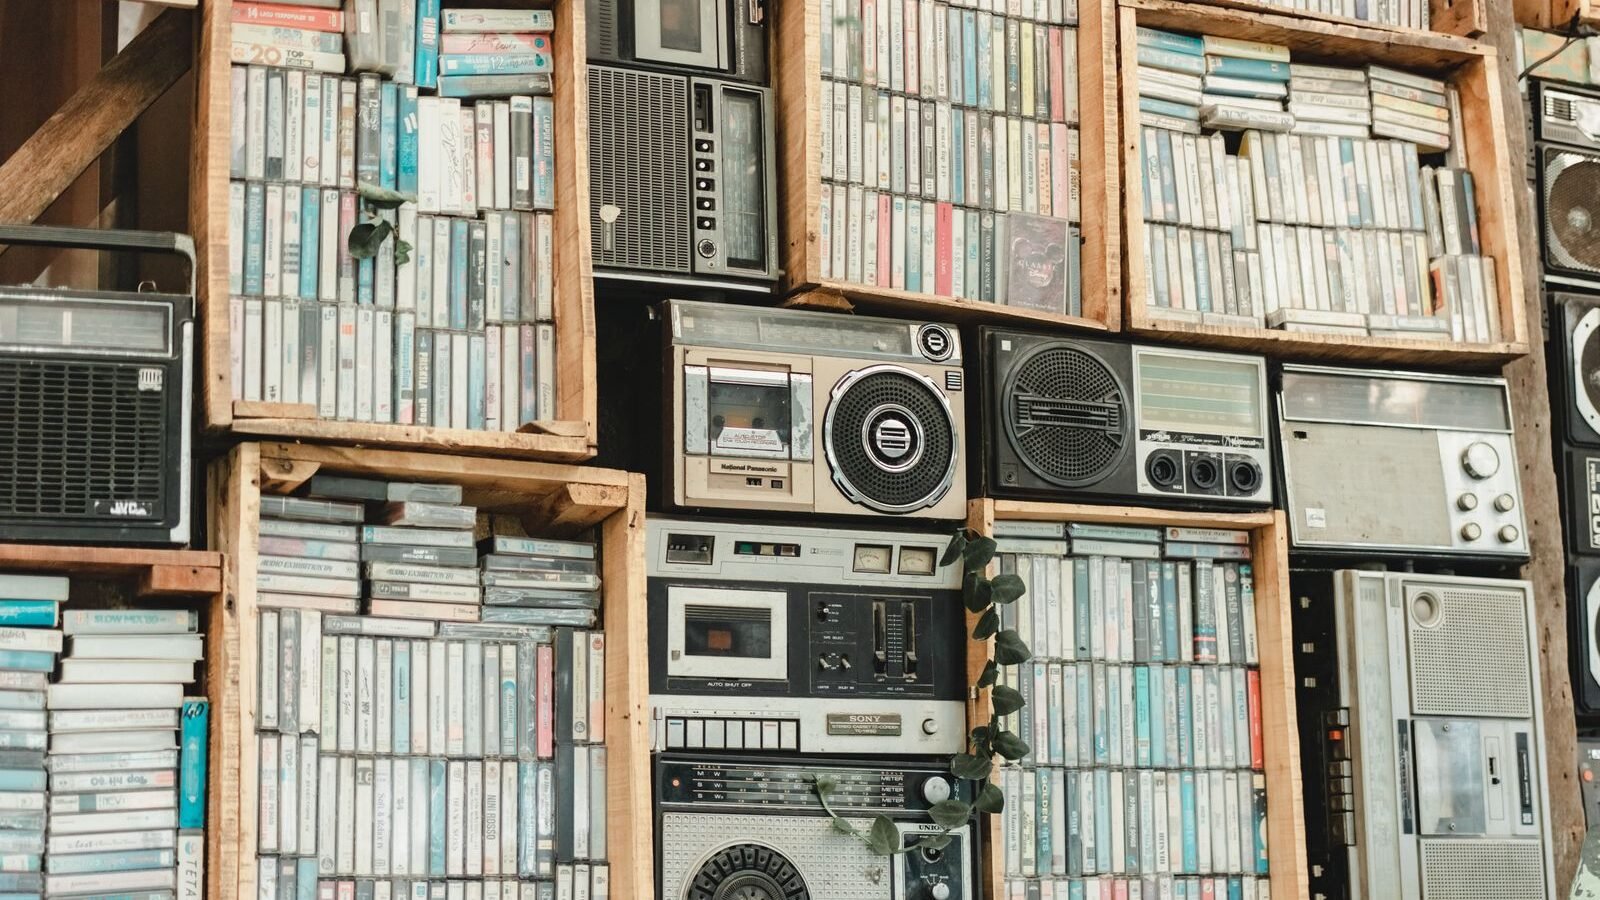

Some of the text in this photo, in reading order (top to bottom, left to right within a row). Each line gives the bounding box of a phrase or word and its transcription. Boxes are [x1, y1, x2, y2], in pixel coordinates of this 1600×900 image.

[250, 44, 282, 65] 20
[286, 50, 304, 58] TOP
[491, 57, 505, 70] 12
[418, 351, 428, 424] PRISKILA group
[721, 463, 778, 472] National Panasonic
[1228, 586, 1238, 614] DISCO
[94, 614, 122, 624] SLOW
[285, 748, 294, 767] TOP
[486, 794, 496, 840] NINI ROSSO
[186, 860, 198, 897] TETA
